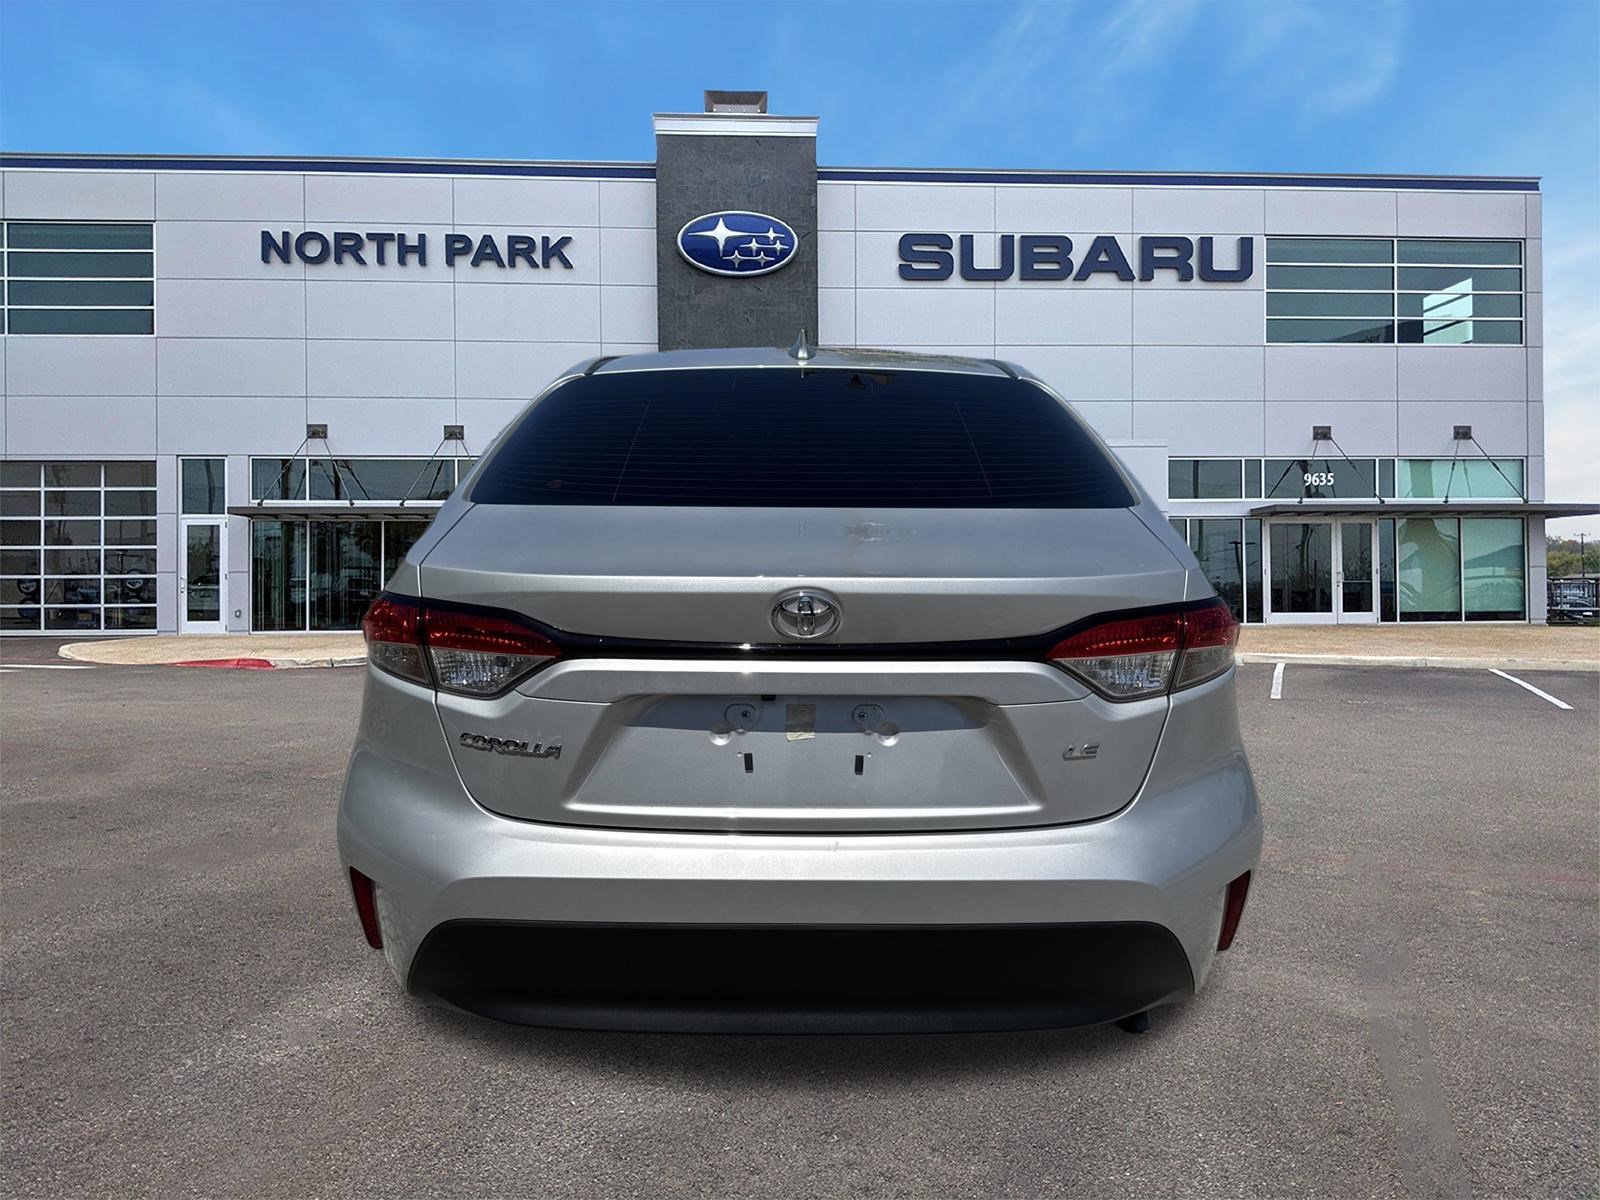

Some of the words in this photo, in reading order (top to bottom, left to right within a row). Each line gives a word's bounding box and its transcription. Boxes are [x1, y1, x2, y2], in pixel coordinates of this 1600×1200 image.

[260, 230, 427, 267] NORTH
[445, 233, 574, 270] PARK
[898, 232, 1254, 282] SUBARU
[1303, 472, 1335, 486] 9635
[459, 732, 562, 760] COROLLA
[1062, 742, 1100, 761] LE
